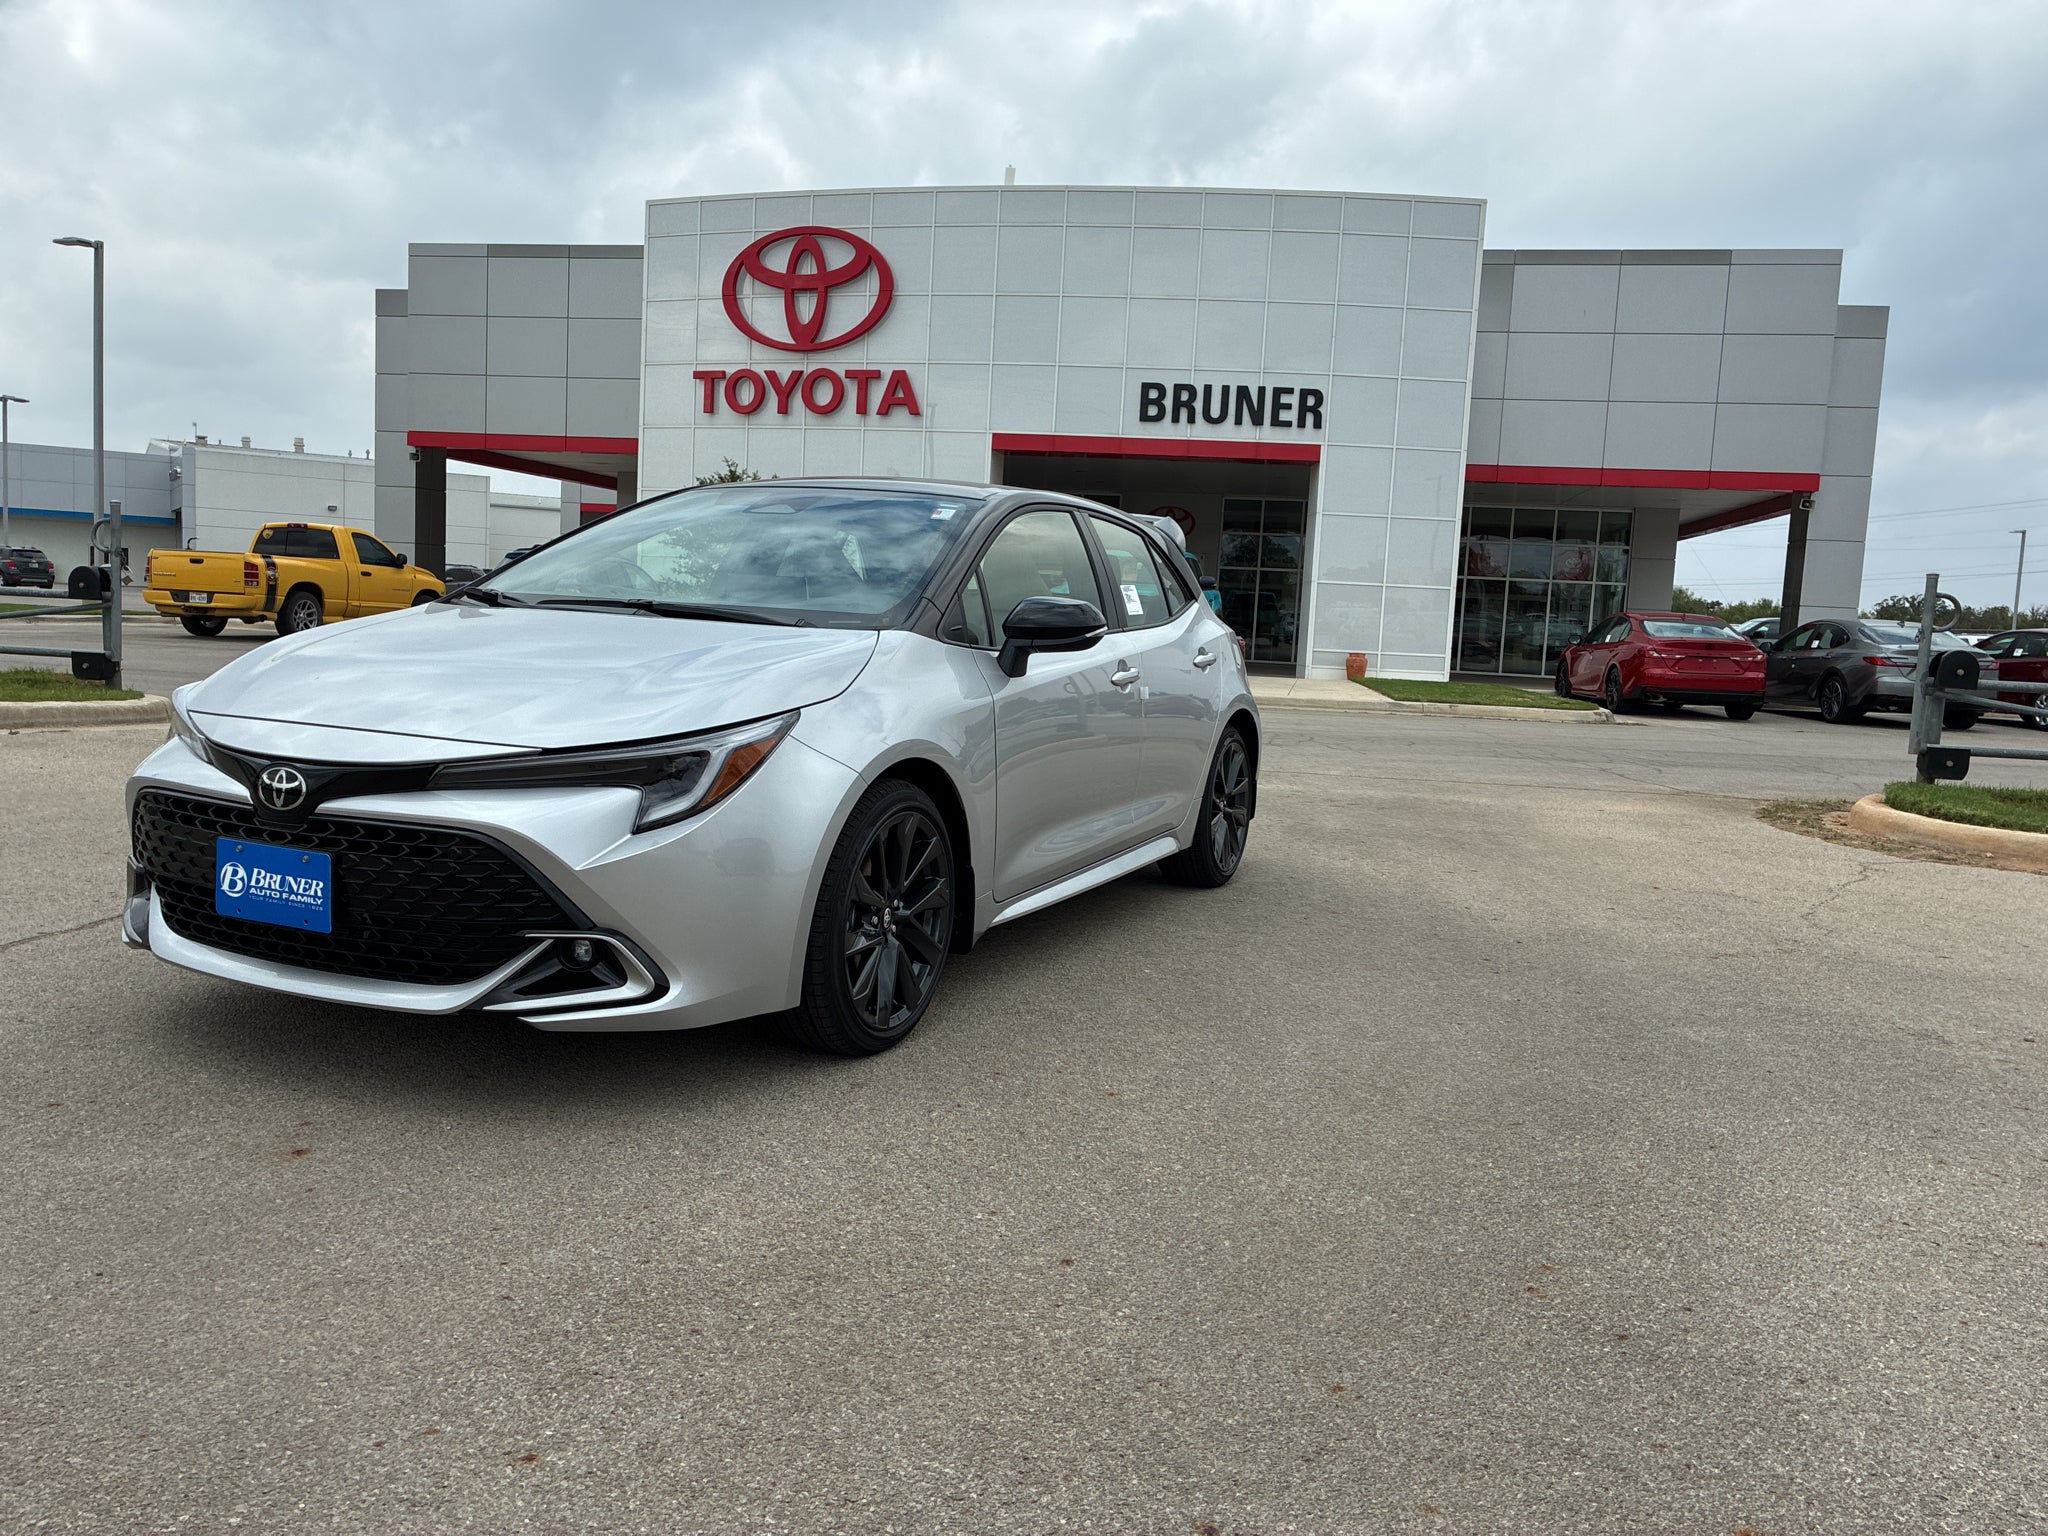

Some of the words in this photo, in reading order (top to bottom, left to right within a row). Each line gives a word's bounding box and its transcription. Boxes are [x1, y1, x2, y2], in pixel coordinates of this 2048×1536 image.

[693, 367, 920, 416] TOYOTA
[1139, 382, 1324, 429] BRUNER
[221, 865, 244, 892] B
[249, 867, 324, 897] BRUNER
[249, 887, 280, 898] AUTO
[282, 892, 324, 905] FAMILY
